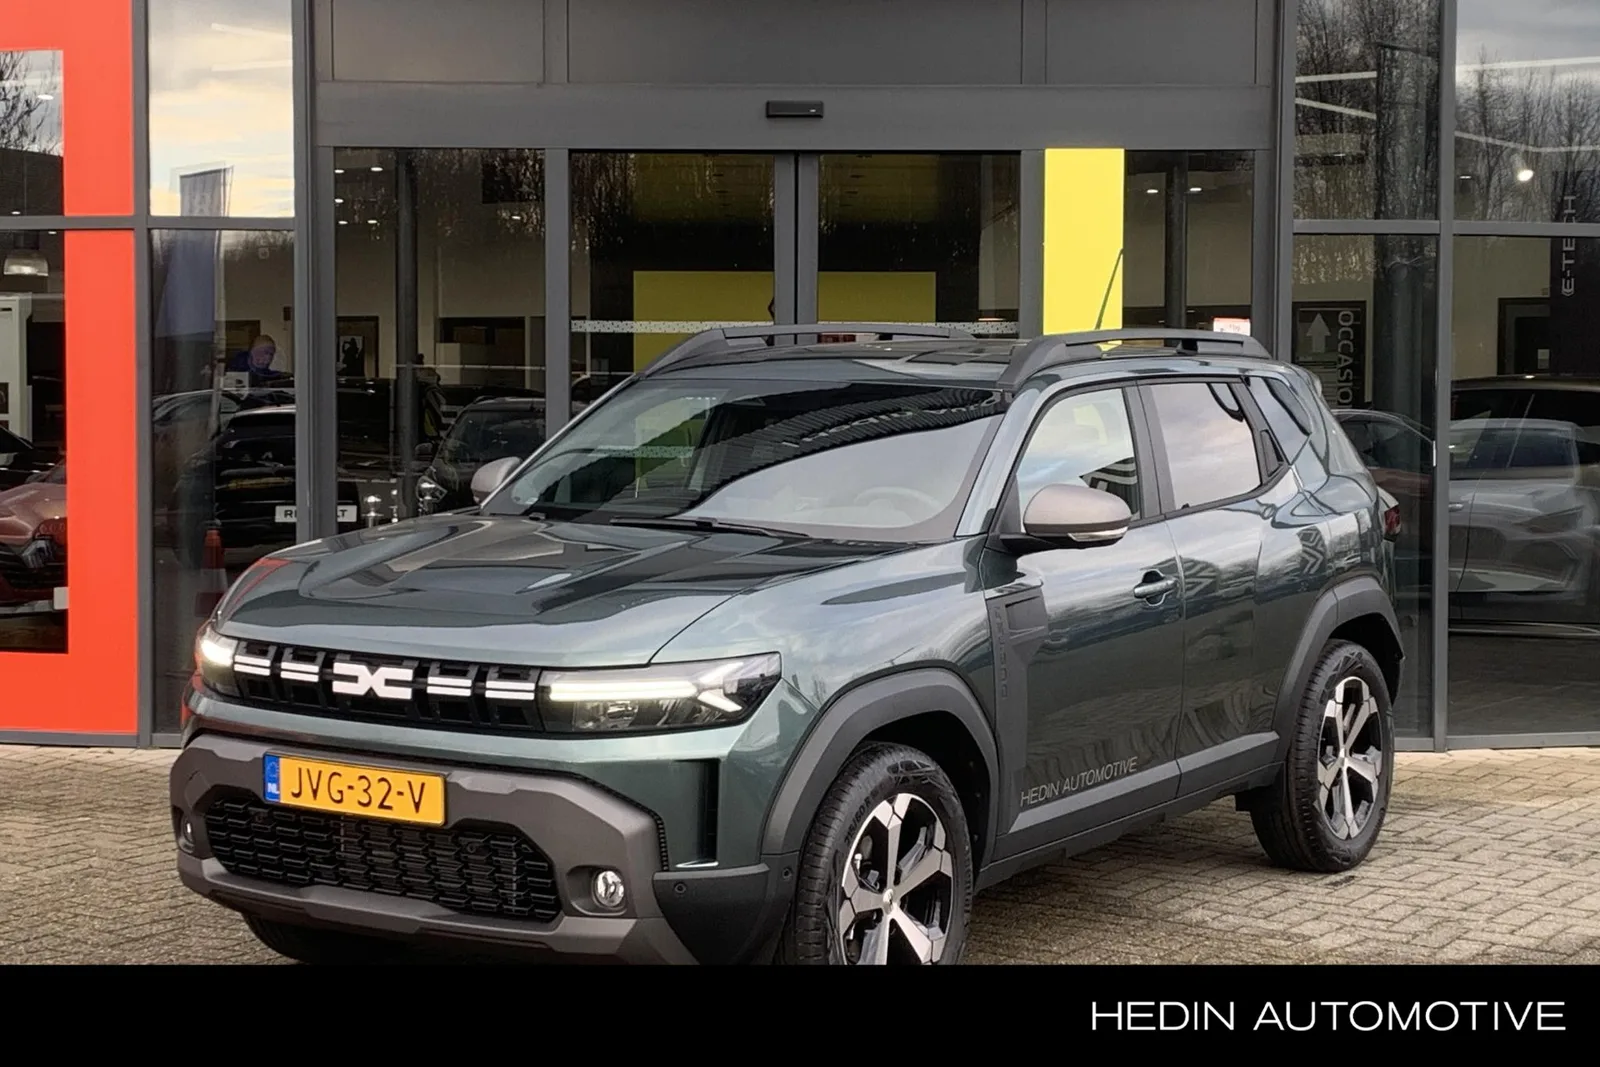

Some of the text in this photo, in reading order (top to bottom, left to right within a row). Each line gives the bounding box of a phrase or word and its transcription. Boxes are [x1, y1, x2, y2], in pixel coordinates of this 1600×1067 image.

[1338, 310, 1355, 408] OCCASIO
[267, 783, 280, 794] NL
[291, 768, 426, 814] JVG-32-V
[1019, 756, 1138, 807] HEDIN AUTOMOTIVE
